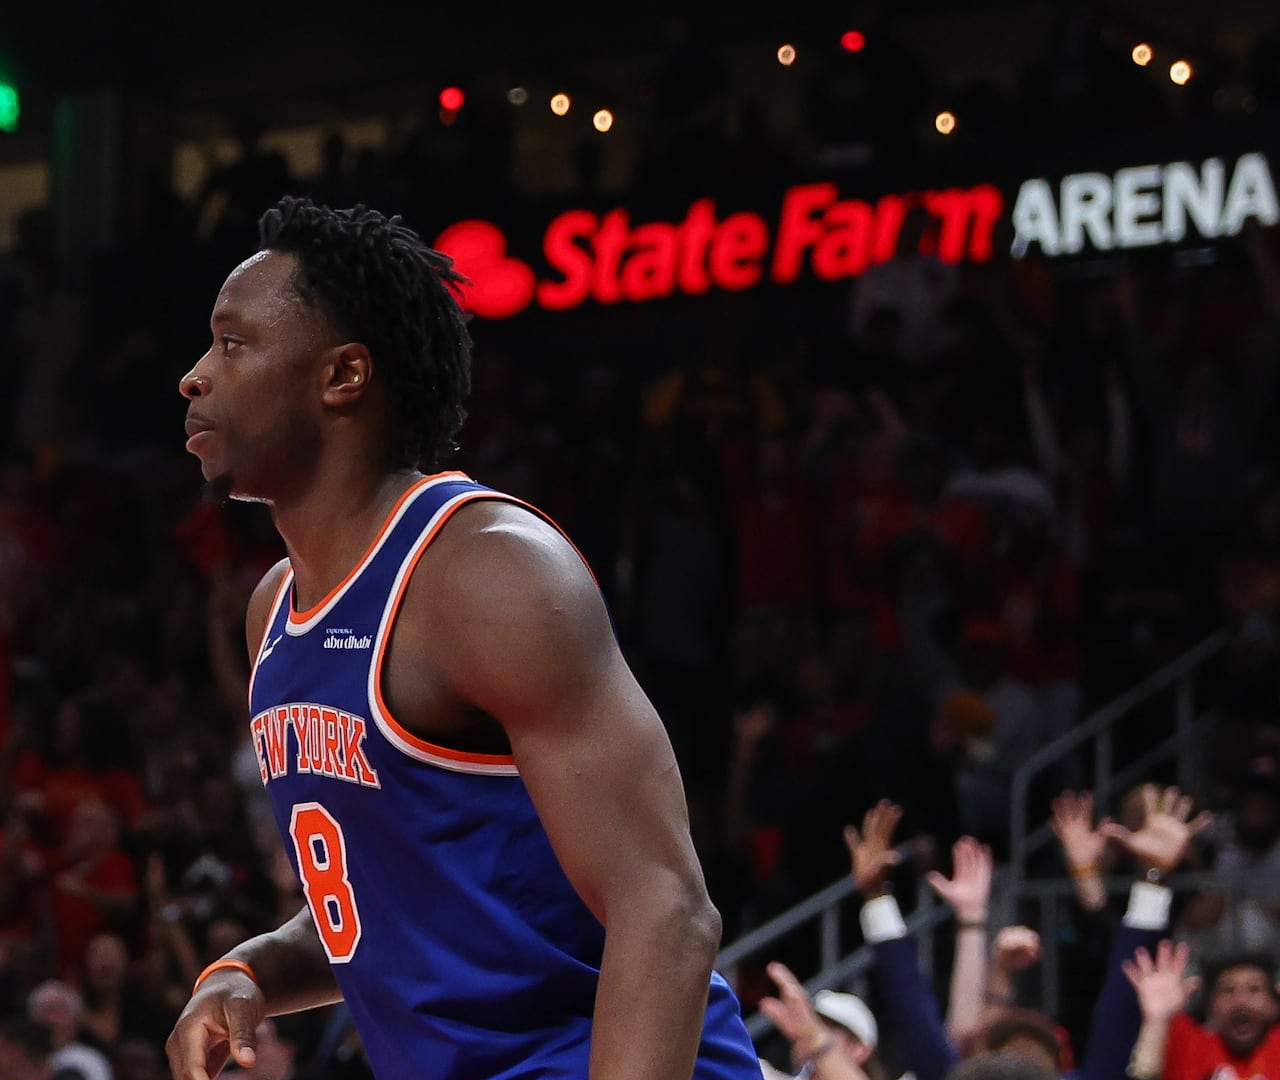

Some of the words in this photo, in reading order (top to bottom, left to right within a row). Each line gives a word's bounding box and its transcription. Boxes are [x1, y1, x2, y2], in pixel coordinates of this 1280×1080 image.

[536, 198, 769, 312] State
[771, 181, 1004, 287] Farm
[1010, 152, 1280, 257] ARENA
[323, 635, 344, 649] abu
[344, 635, 373, 649] dhabi
[251, 705, 289, 787] EW
[288, 702, 382, 790] YORK
[289, 801, 362, 964] 8
